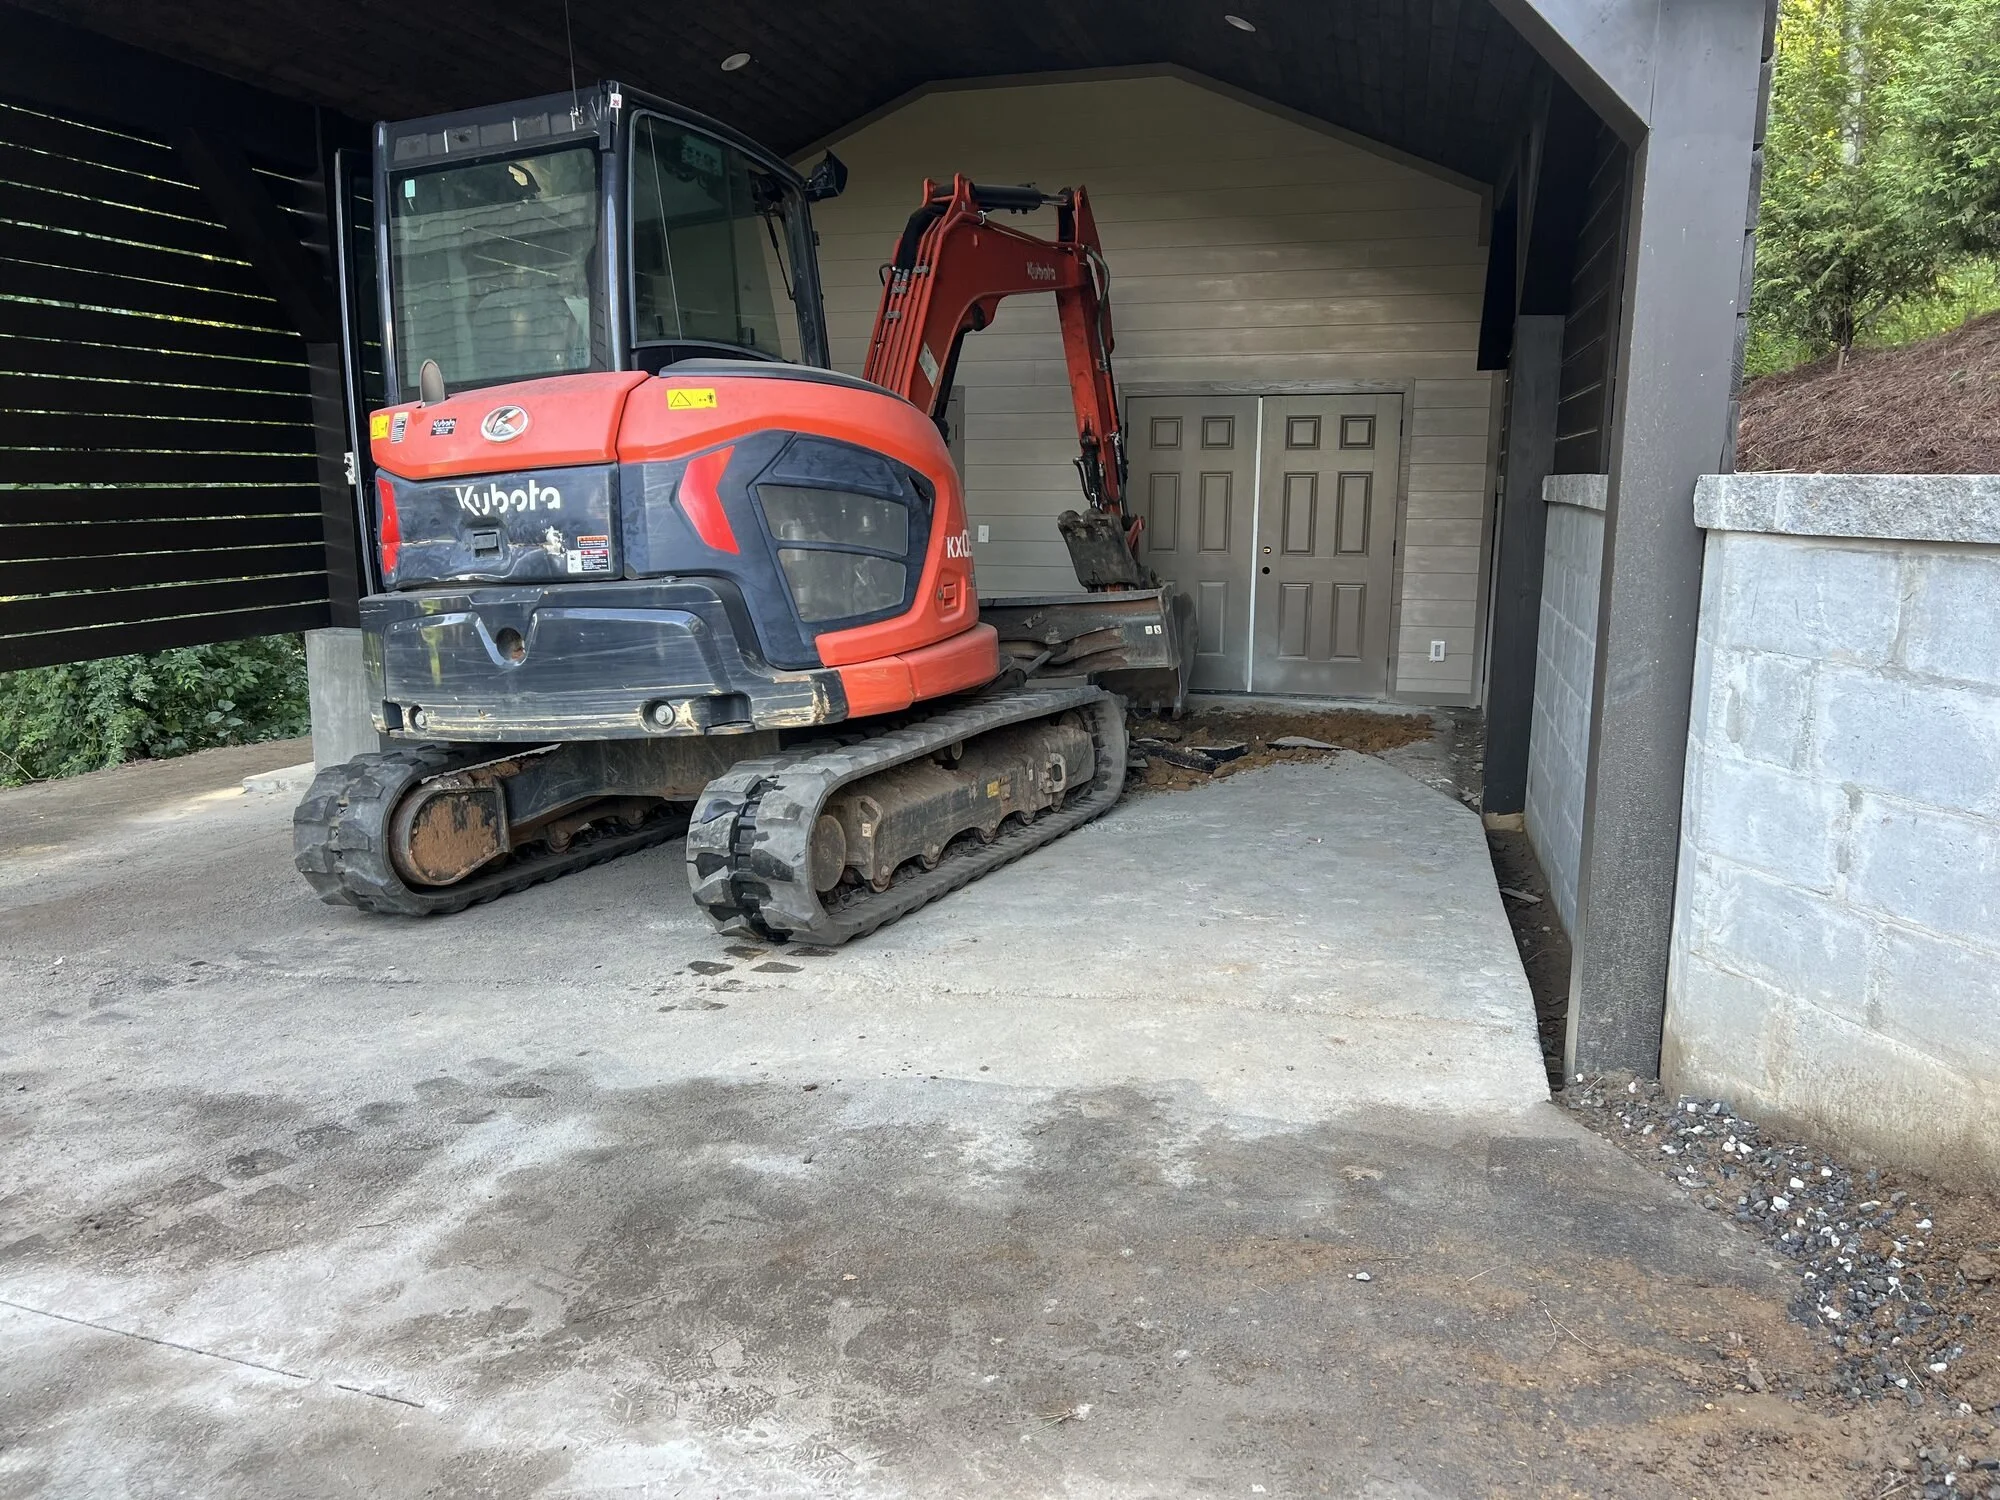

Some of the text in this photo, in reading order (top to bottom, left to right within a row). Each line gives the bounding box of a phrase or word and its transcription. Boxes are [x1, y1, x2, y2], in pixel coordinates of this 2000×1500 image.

[1027, 261, 1056, 280] Kubota
[455, 479, 561, 516] Kubota
[947, 529, 972, 558] KX0
